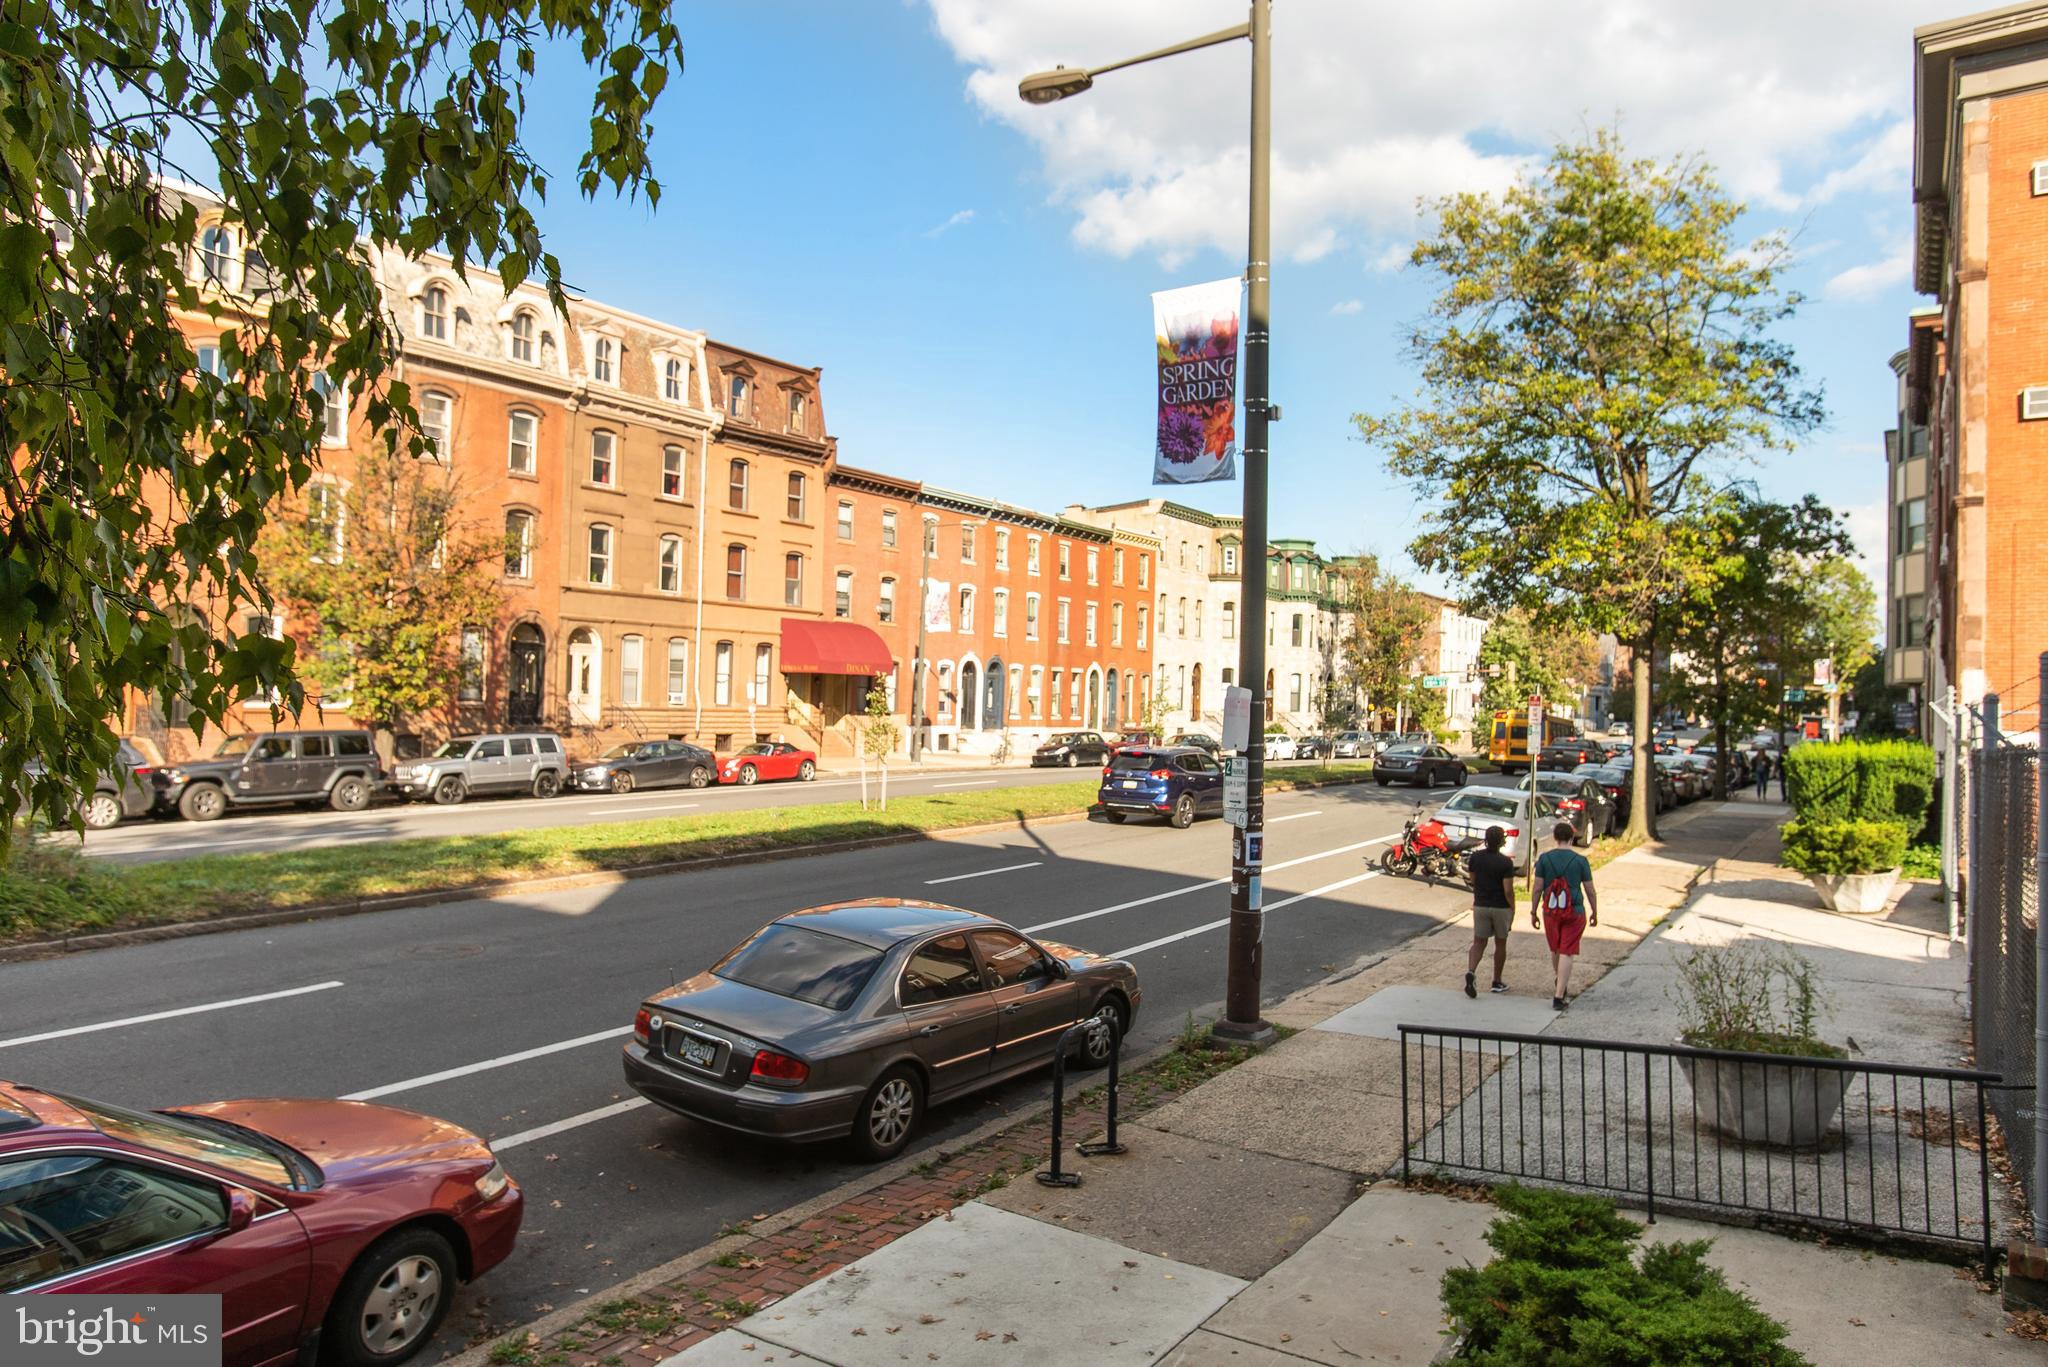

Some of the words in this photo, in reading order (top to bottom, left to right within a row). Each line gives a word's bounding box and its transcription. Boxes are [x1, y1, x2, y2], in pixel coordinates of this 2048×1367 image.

[1162, 357, 1233, 385] SPRING
[1162, 377, 1234, 404] GARDEN
[1226, 760, 1231, 774] 2
